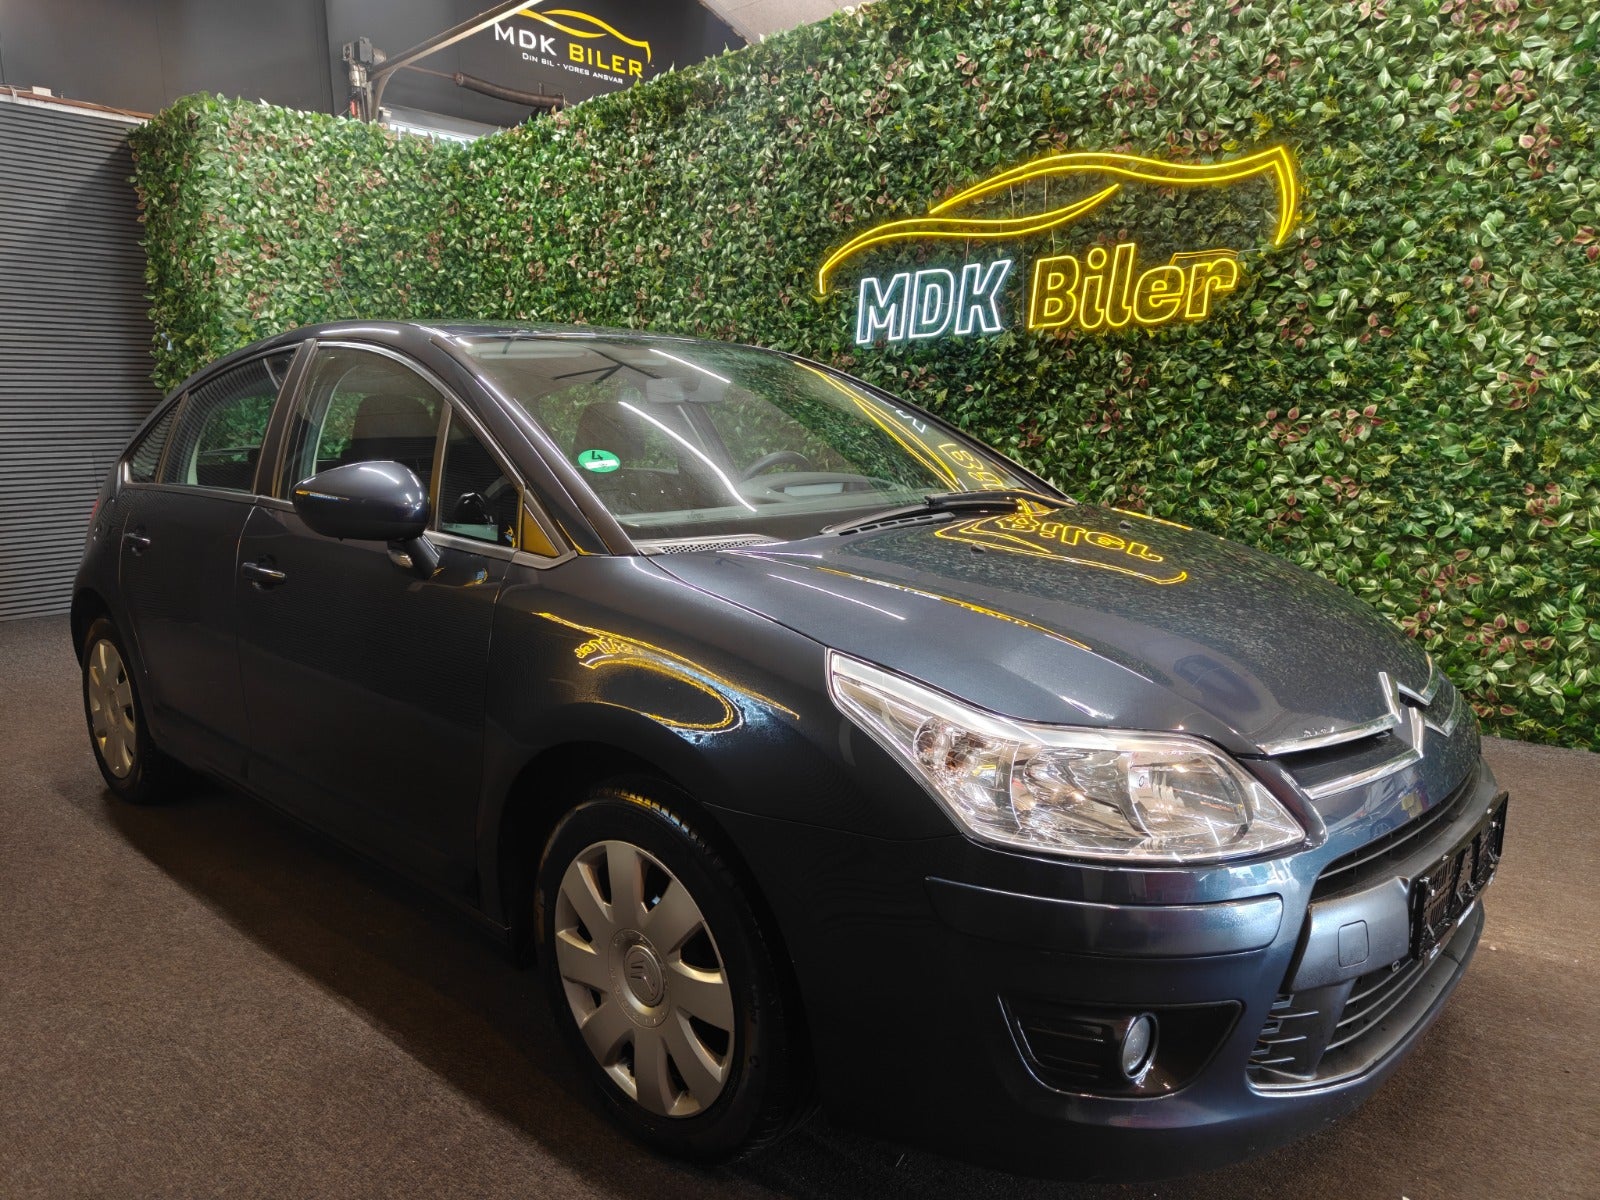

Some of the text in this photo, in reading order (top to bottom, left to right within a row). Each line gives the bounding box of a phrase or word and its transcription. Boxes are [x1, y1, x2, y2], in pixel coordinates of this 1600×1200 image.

[494, 22, 644, 79] MDK BILER
[563, 63, 590, 76] VORES
[592, 71, 624, 84] ANSVAR
[856, 242, 1238, 345] MDK Biler
